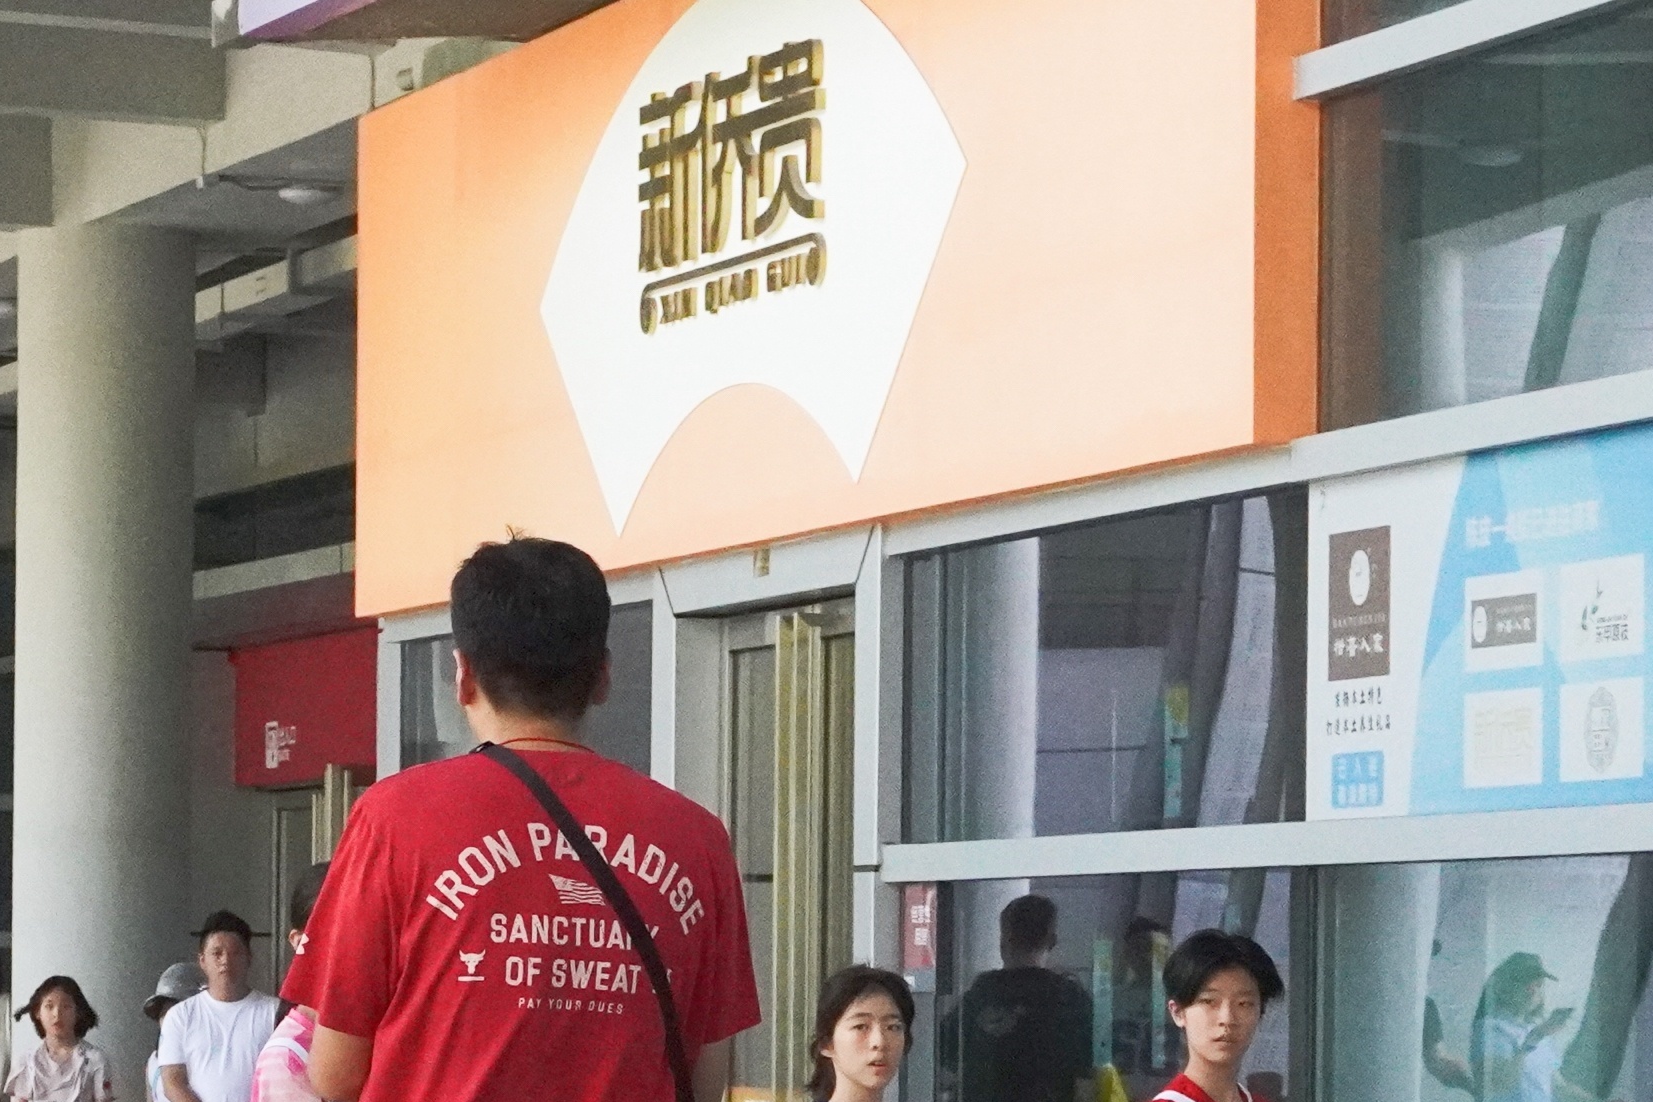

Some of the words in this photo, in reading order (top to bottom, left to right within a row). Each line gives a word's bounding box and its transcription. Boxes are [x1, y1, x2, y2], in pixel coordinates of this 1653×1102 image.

[425, 828, 522, 921] IRON
[490, 913, 659, 951] SANCTUA
[505, 956, 542, 987] OF
[551, 958, 643, 994] SWEAT
[518, 997, 542, 1009] PAY
[548, 998, 583, 1012] YOUR
[588, 1001, 625, 1015] DUES
